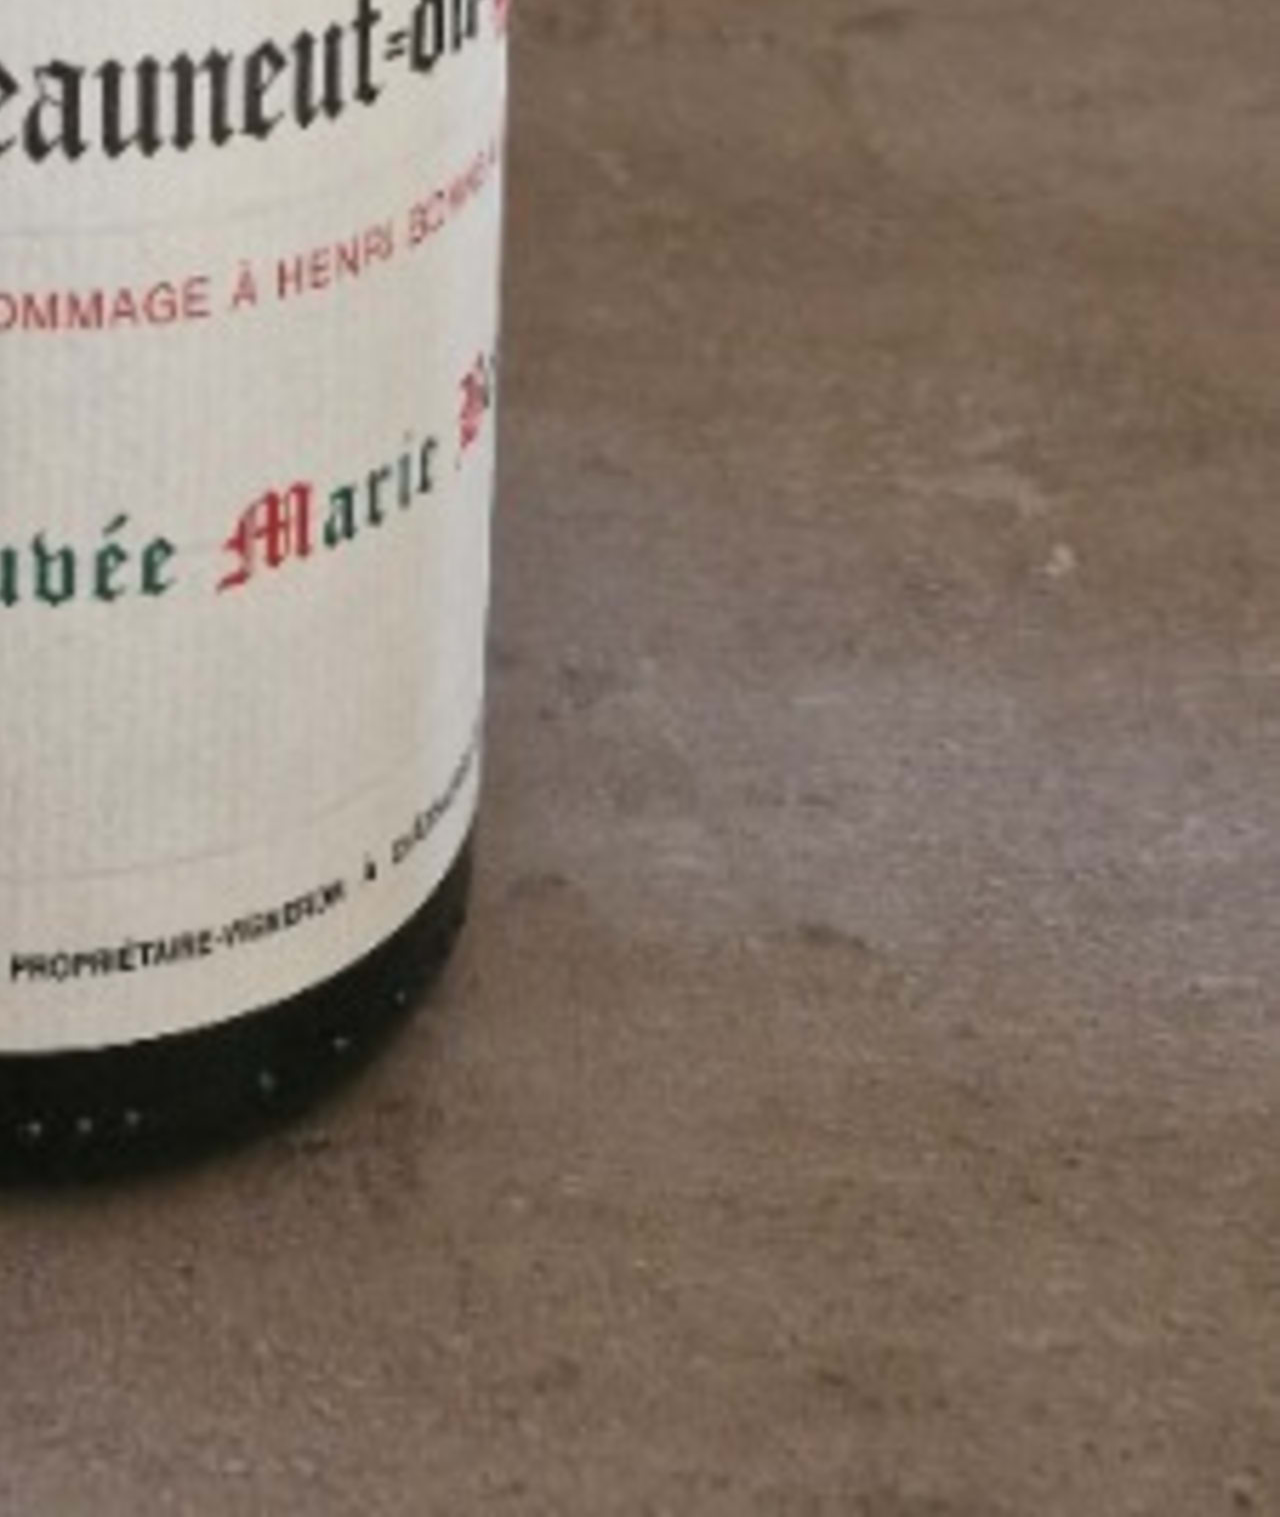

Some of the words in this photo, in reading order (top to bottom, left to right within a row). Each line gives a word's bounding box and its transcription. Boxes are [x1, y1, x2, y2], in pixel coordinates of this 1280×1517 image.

[230, 260, 259, 309] À
[277, 218, 395, 300] HENRI
[214, 432, 439, 591] Marie
